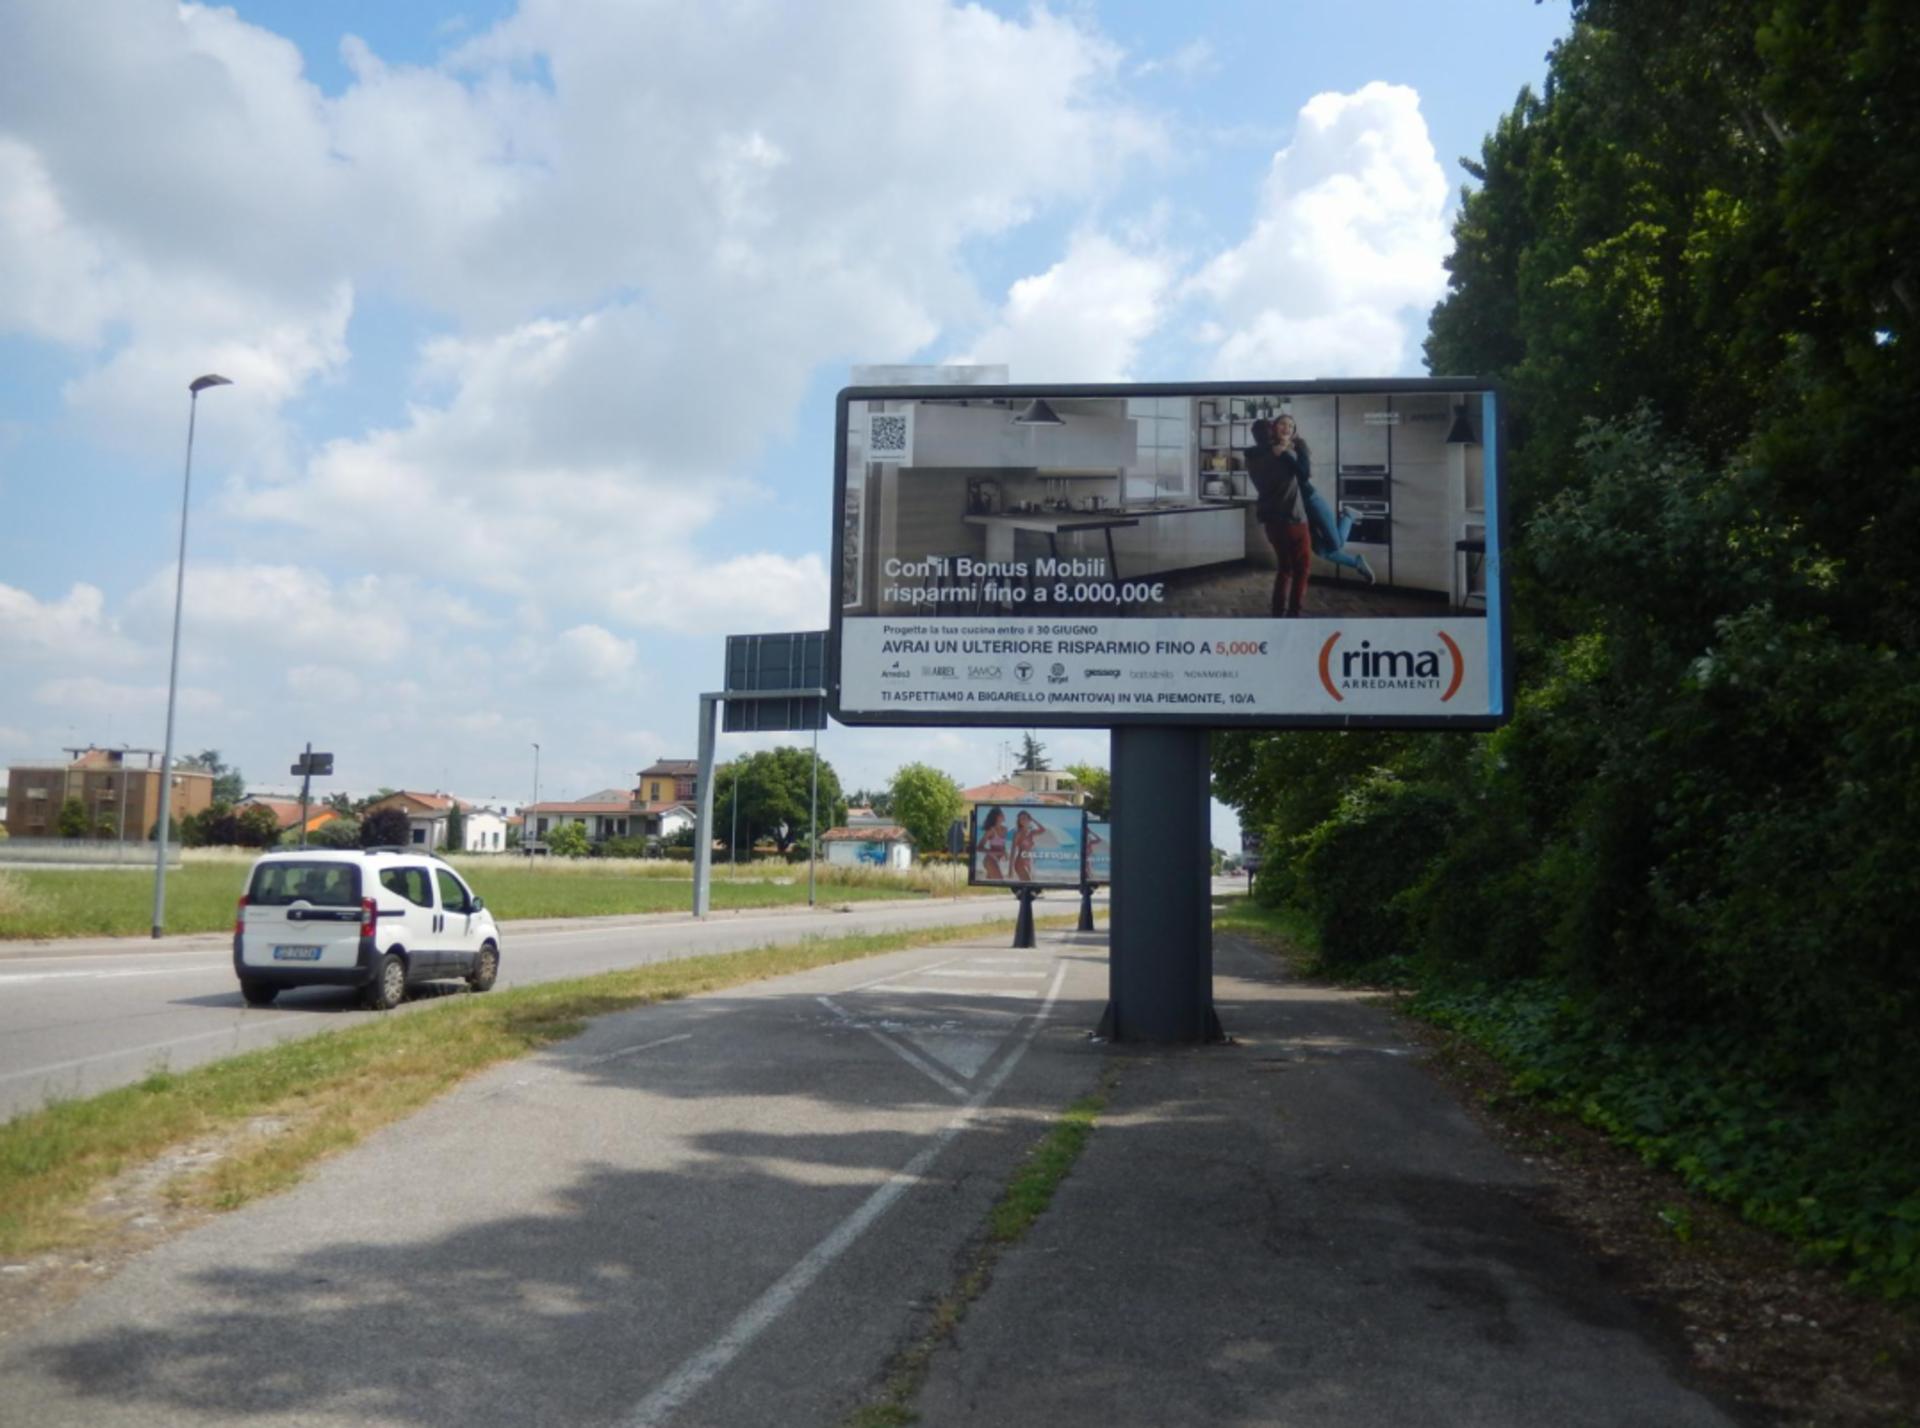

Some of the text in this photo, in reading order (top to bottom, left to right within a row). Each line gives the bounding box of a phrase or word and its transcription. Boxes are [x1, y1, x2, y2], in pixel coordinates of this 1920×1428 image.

[885, 557, 1105, 577] Con il Bonus Mobili
[885, 582, 1164, 606] risparmi fino a 8.000,00€
[930, 625, 939, 635] la
[941, 626, 958, 635] tua
[961, 626, 995, 635] cucina
[997, 626, 1024, 635] entro
[1036, 626, 1050, 635] 30
[1052, 626, 1098, 635] GIUGNO
[882, 640, 1268, 657] AVRAI UN ULTERIORE RISPARMIO FINO A 5,000€
[1343, 640, 1439, 677] rima
[1343, 679, 1440, 688] ARREDAMENTI
[882, 691, 892, 701] TI
[894, 691, 964, 702] ASPETTIAMO
[966, 691, 975, 702] A
[978, 692, 1045, 703] BIGARELLO
[1118, 694, 1131, 703] IN
[1134, 694, 1154, 703] VIA
[1157, 694, 1226, 705] PIEMONTE,
[1229, 694, 1255, 704] 10/A
